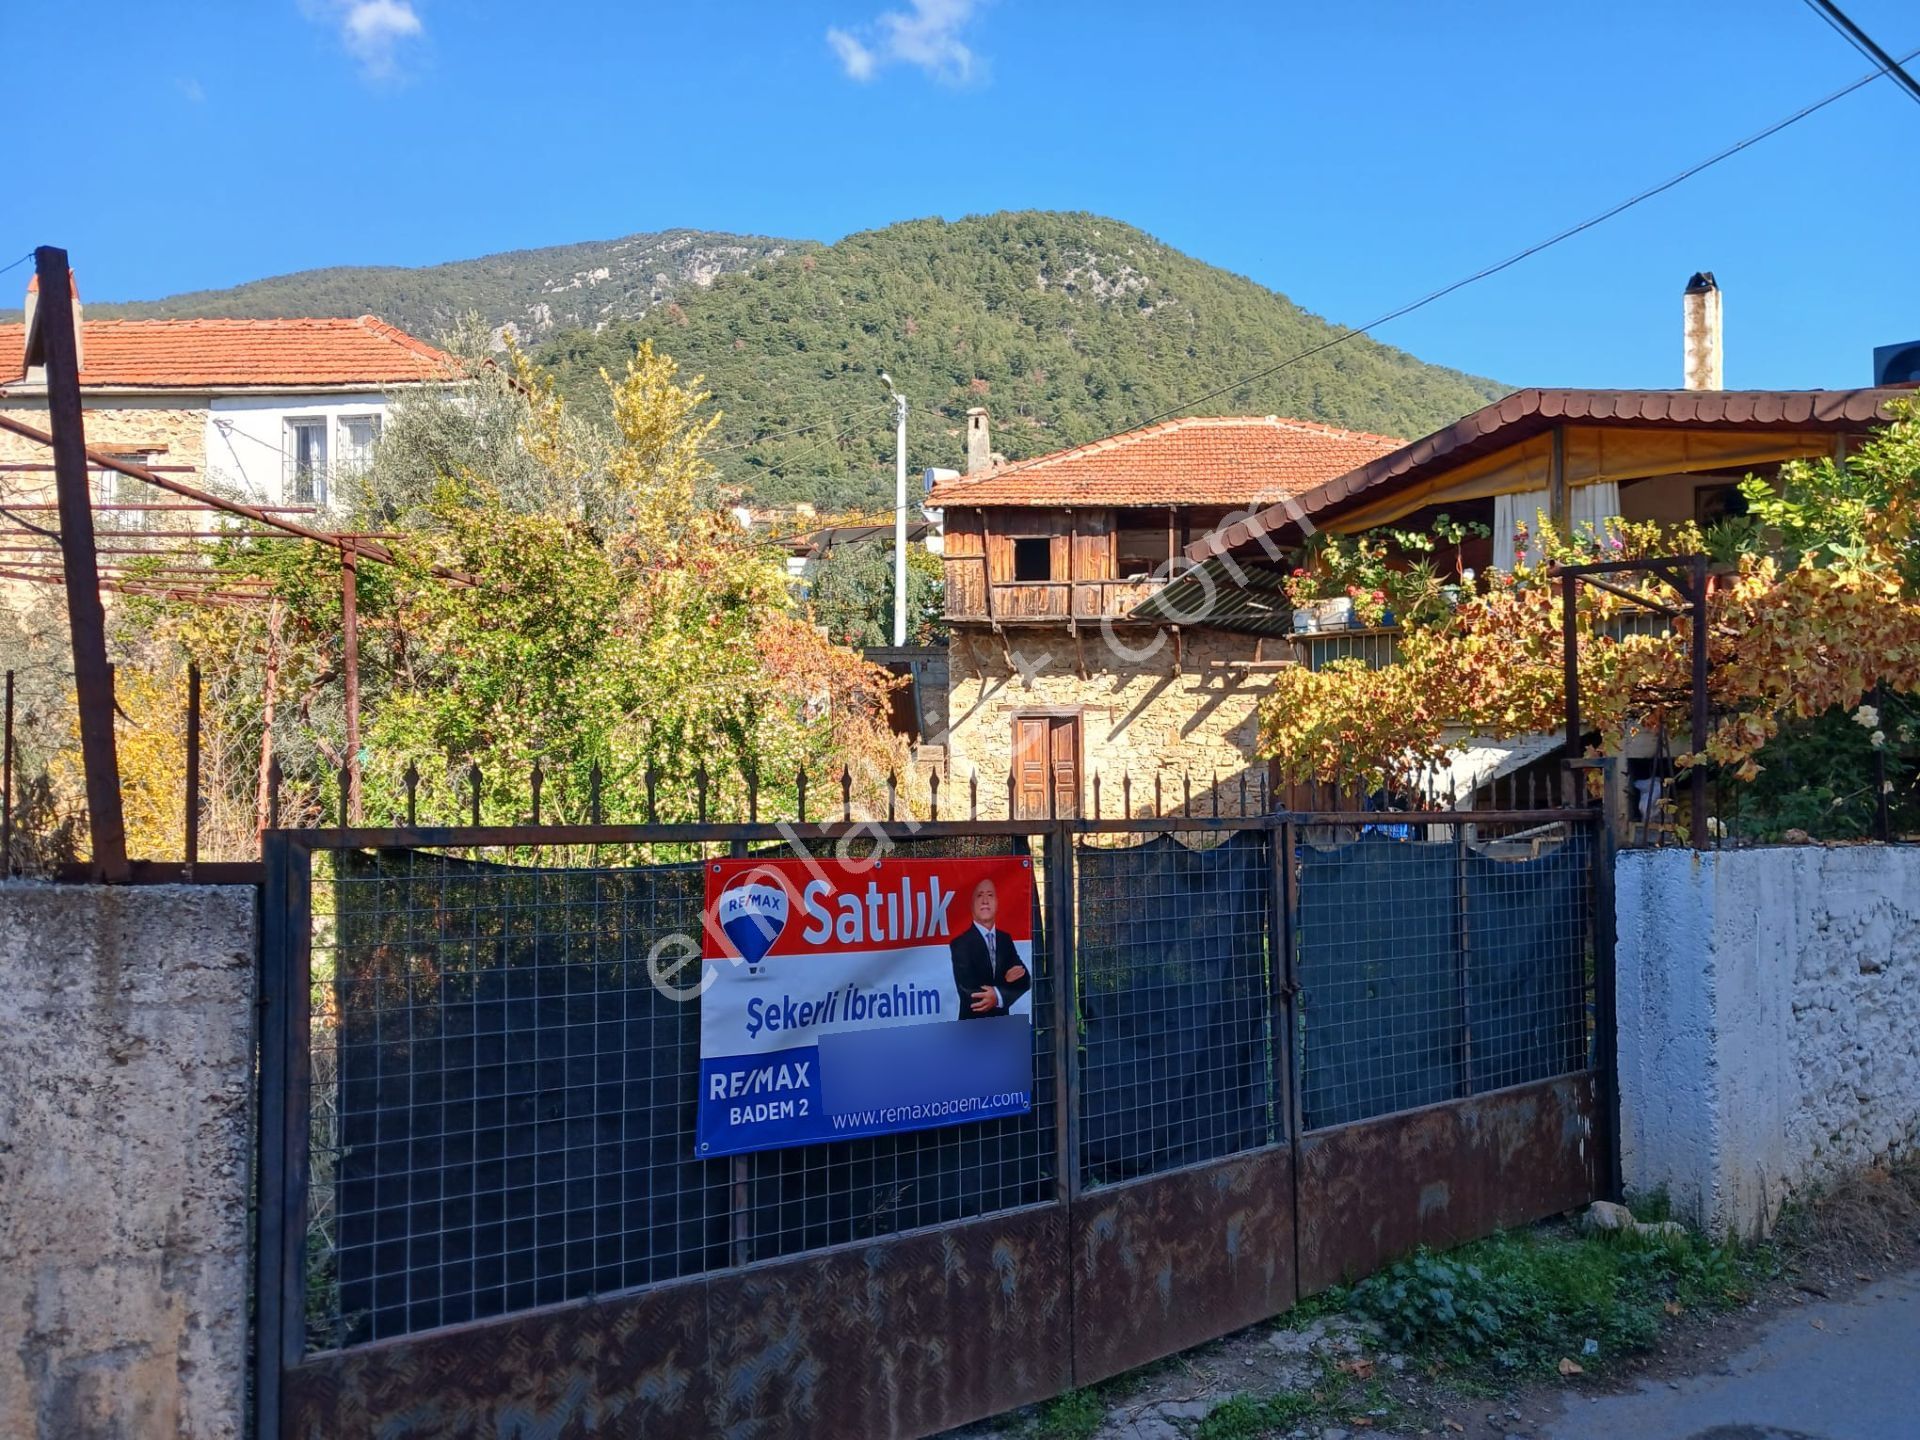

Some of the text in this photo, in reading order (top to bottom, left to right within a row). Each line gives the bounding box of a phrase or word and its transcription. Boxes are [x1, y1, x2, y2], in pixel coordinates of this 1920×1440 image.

[729, 893, 781, 912] RE/MAX
[802, 876, 956, 945] Satılık
[746, 982, 941, 1039] Şekerli İbrahim
[709, 1061, 811, 1101] RE/MAX
[729, 1098, 809, 1126] BADEM 2
